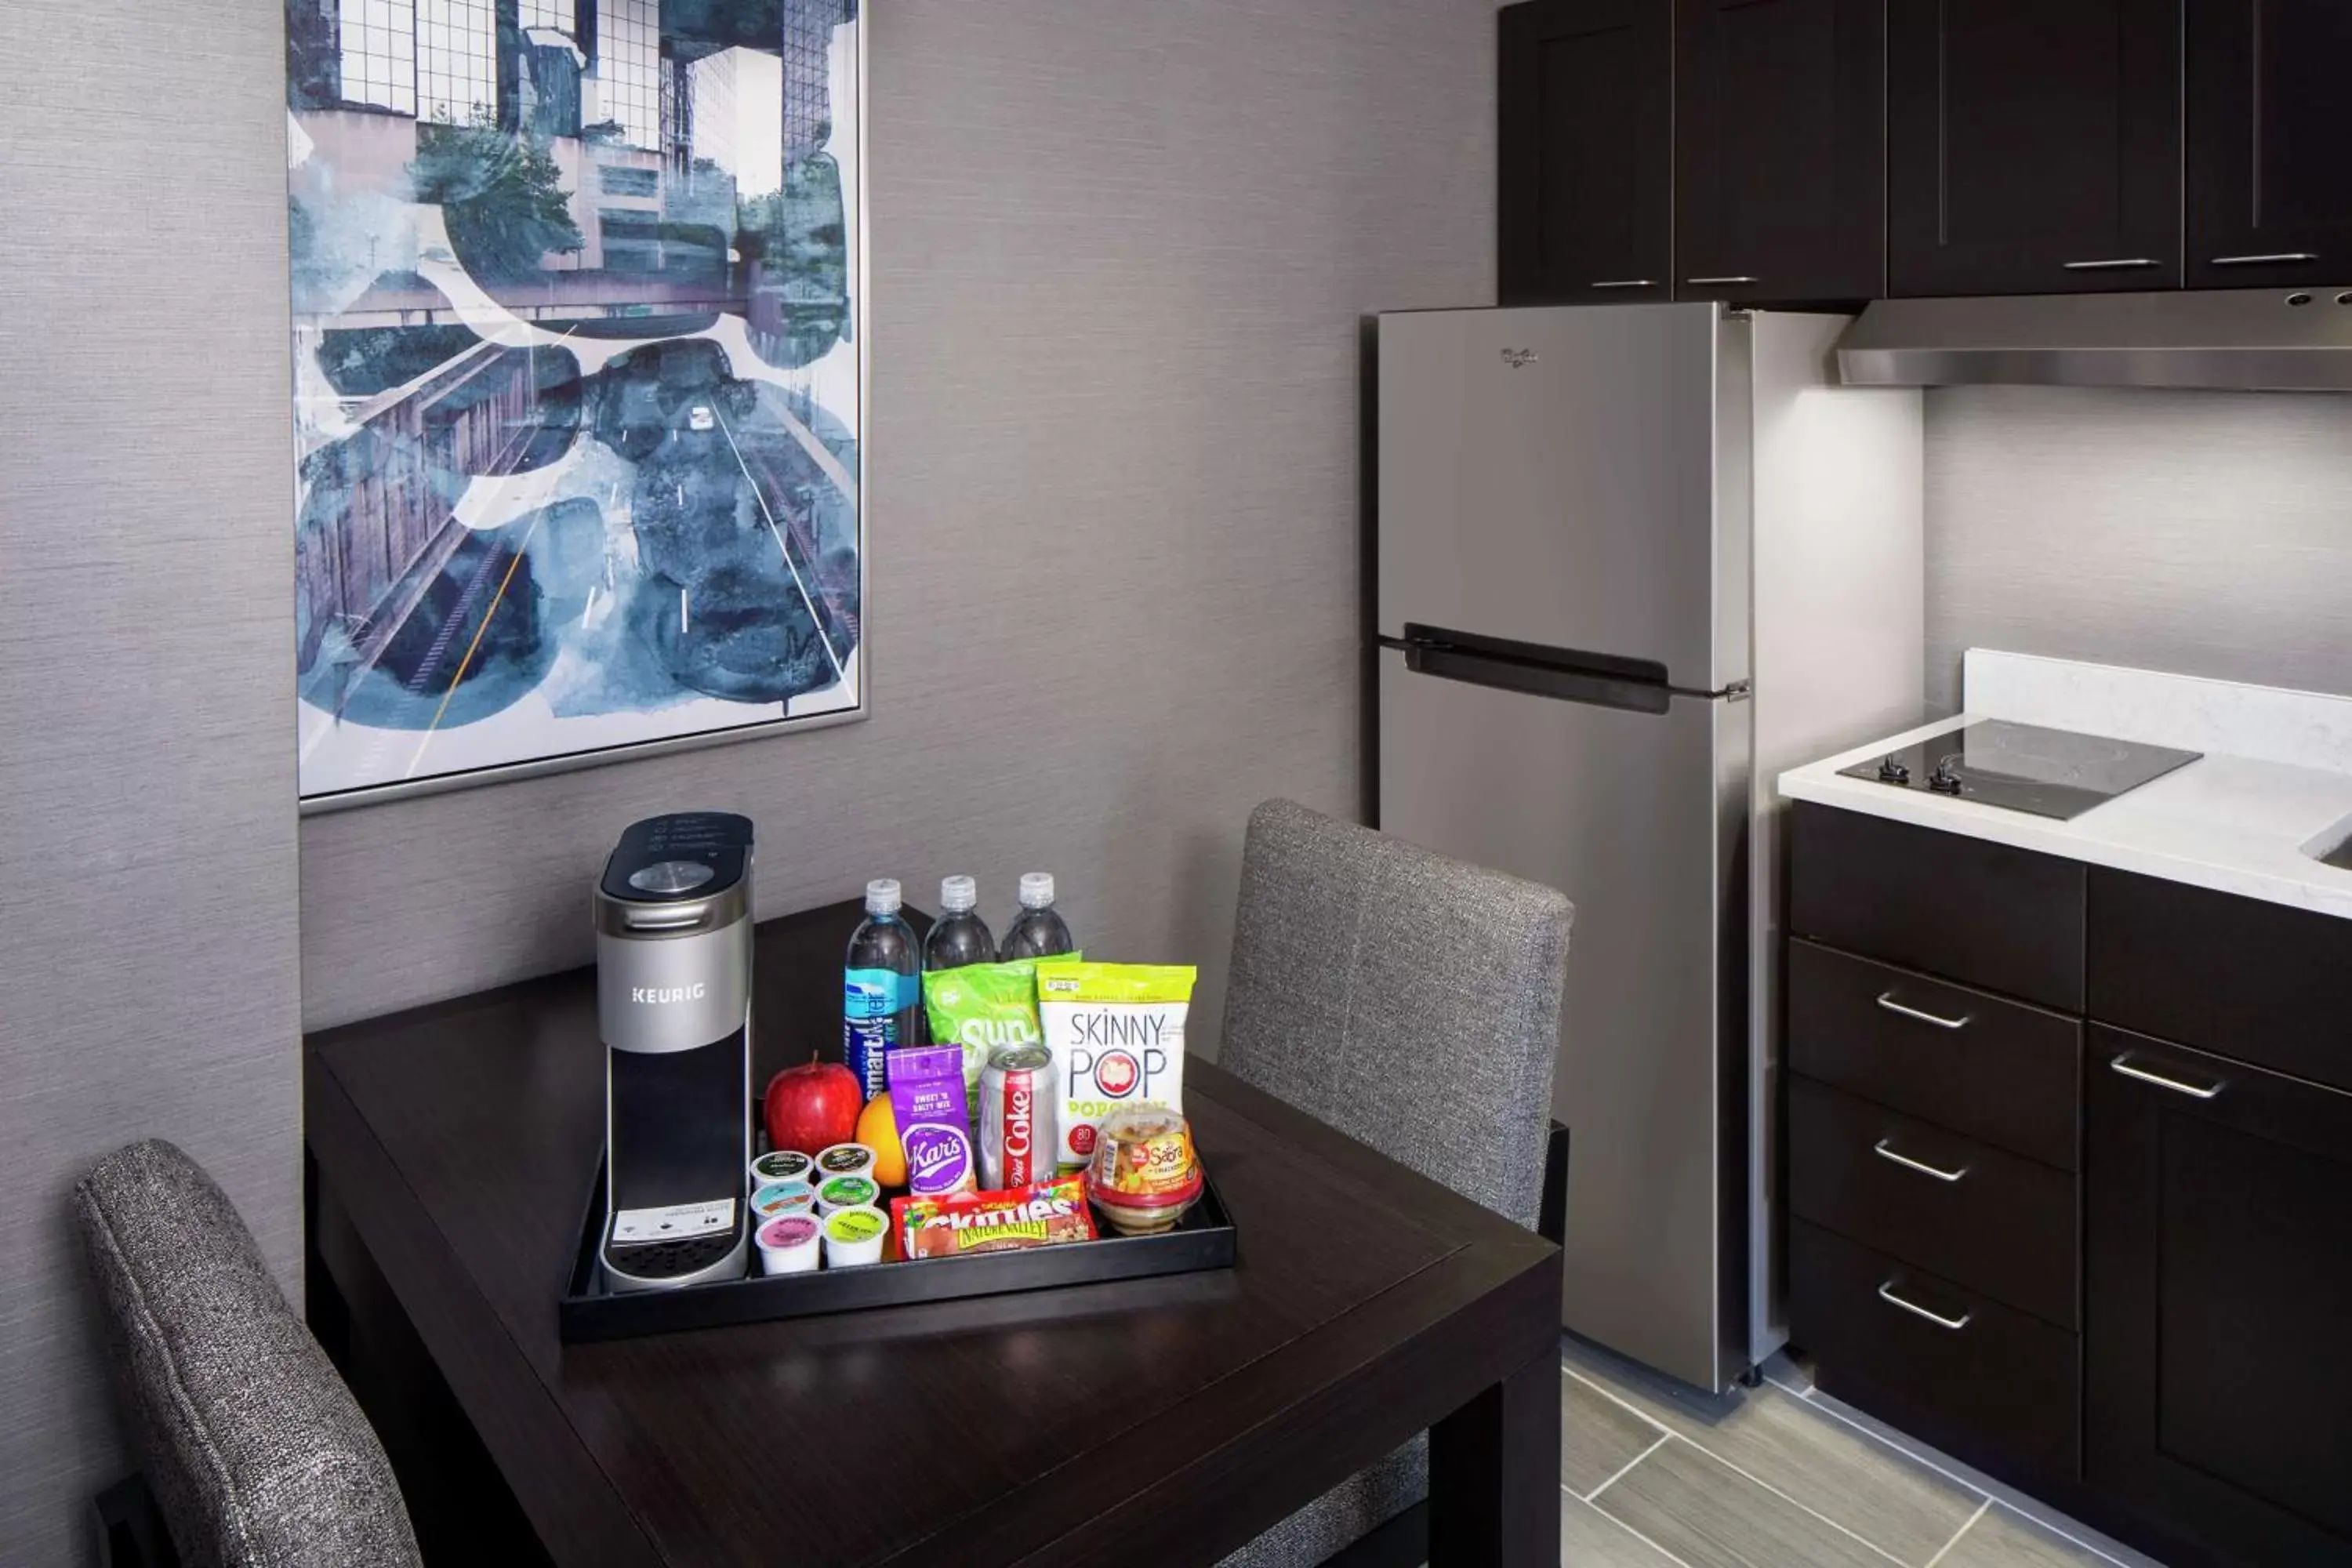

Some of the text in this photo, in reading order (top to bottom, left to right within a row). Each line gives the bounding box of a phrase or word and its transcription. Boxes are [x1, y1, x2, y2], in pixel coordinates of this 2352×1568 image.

[632, 983, 704, 1004] KEURIG
[1069, 1048, 1167, 1099] POP
[1005, 1091, 1030, 1157] Coke
[909, 1137, 960, 1175] Kar's
[1011, 1158, 1024, 1188] Diet
[1005, 1220, 1044, 1238] VALLEY
